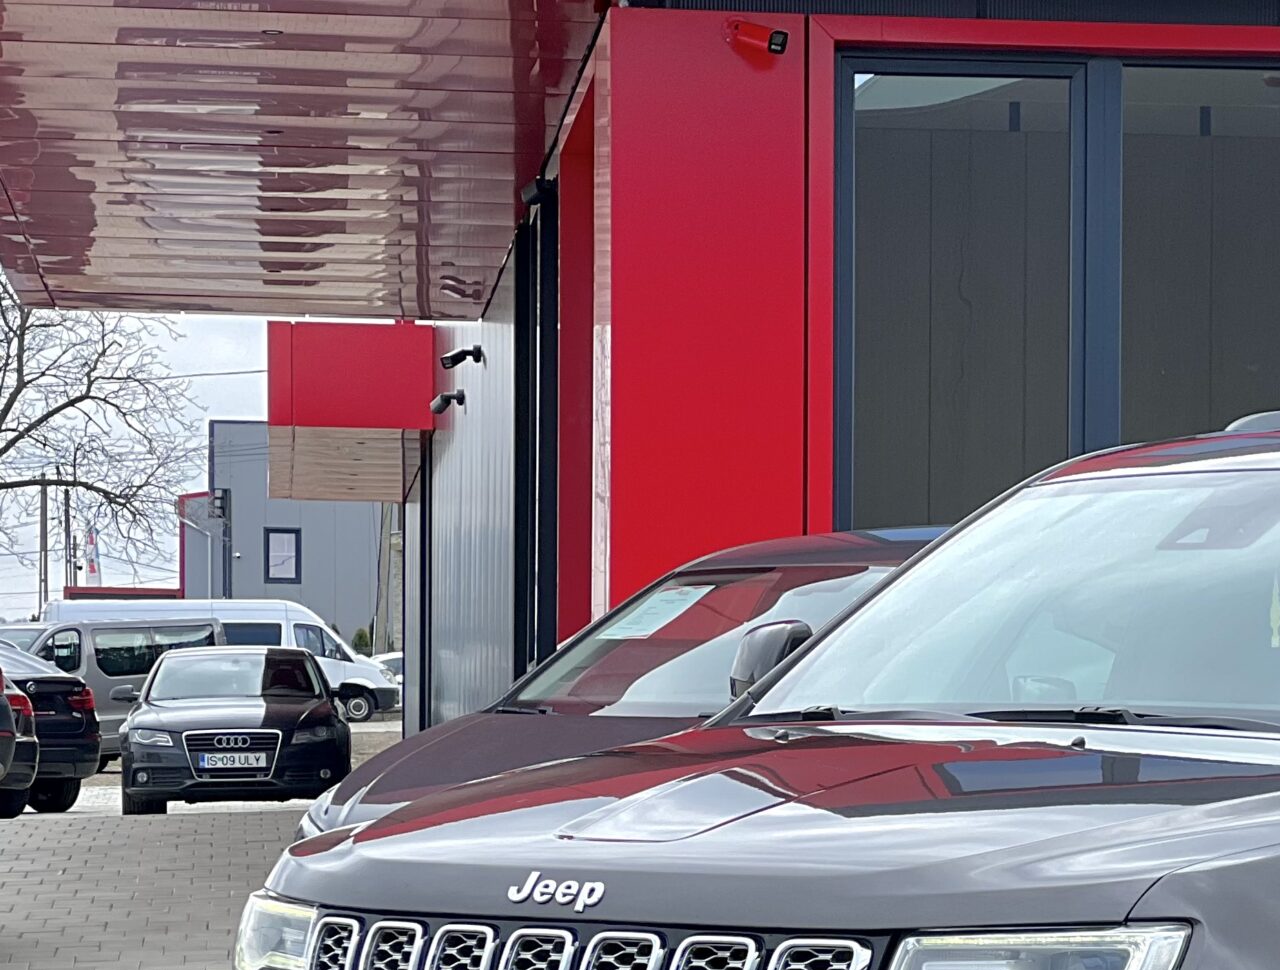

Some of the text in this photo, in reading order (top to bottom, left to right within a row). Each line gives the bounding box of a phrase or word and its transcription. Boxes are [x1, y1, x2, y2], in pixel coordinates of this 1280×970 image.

[206, 755, 261, 766] IS 09 ULY
[507, 870, 605, 913] Jeep
